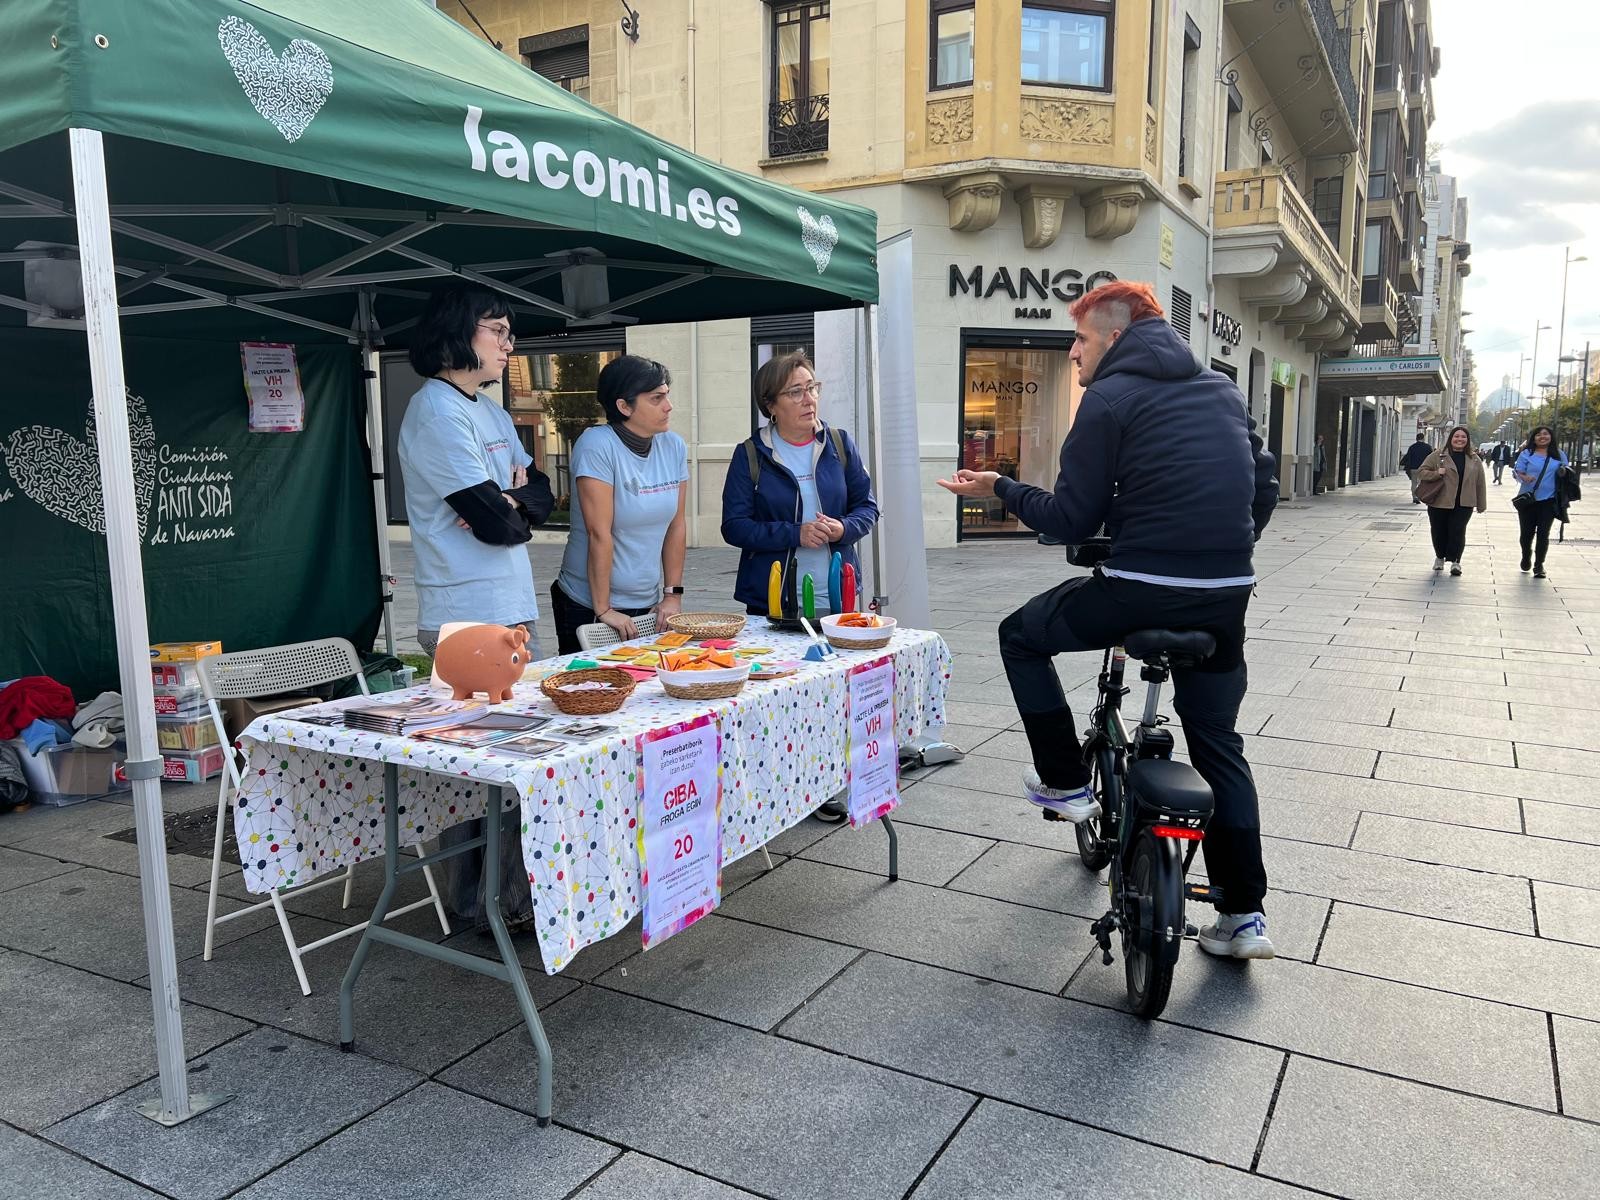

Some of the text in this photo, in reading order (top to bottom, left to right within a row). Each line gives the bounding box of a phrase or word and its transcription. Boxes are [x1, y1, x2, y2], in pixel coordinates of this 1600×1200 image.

[463, 104, 742, 237] lacomi.es
[1015, 307, 1052, 319] MAN
[1398, 361, 1423, 370] CARLOS
[264, 375, 283, 385] VIH
[972, 381, 1038, 394] MANGO
[269, 389, 282, 398] 20
[159, 444, 229, 465] Comisión
[158, 465, 234, 486] Ciudadana
[158, 483, 233, 522] ANTI SIDA
[151, 522, 235, 546] de Navarra
[854, 698, 889, 723] HAZTE LA PRUEBA
[865, 713, 881, 737] VIH
[866, 740, 879, 759] 20
[663, 779, 698, 811] GIBA
[660, 796, 702, 826] FROGA EGIN
[674, 834, 694, 860] 20
